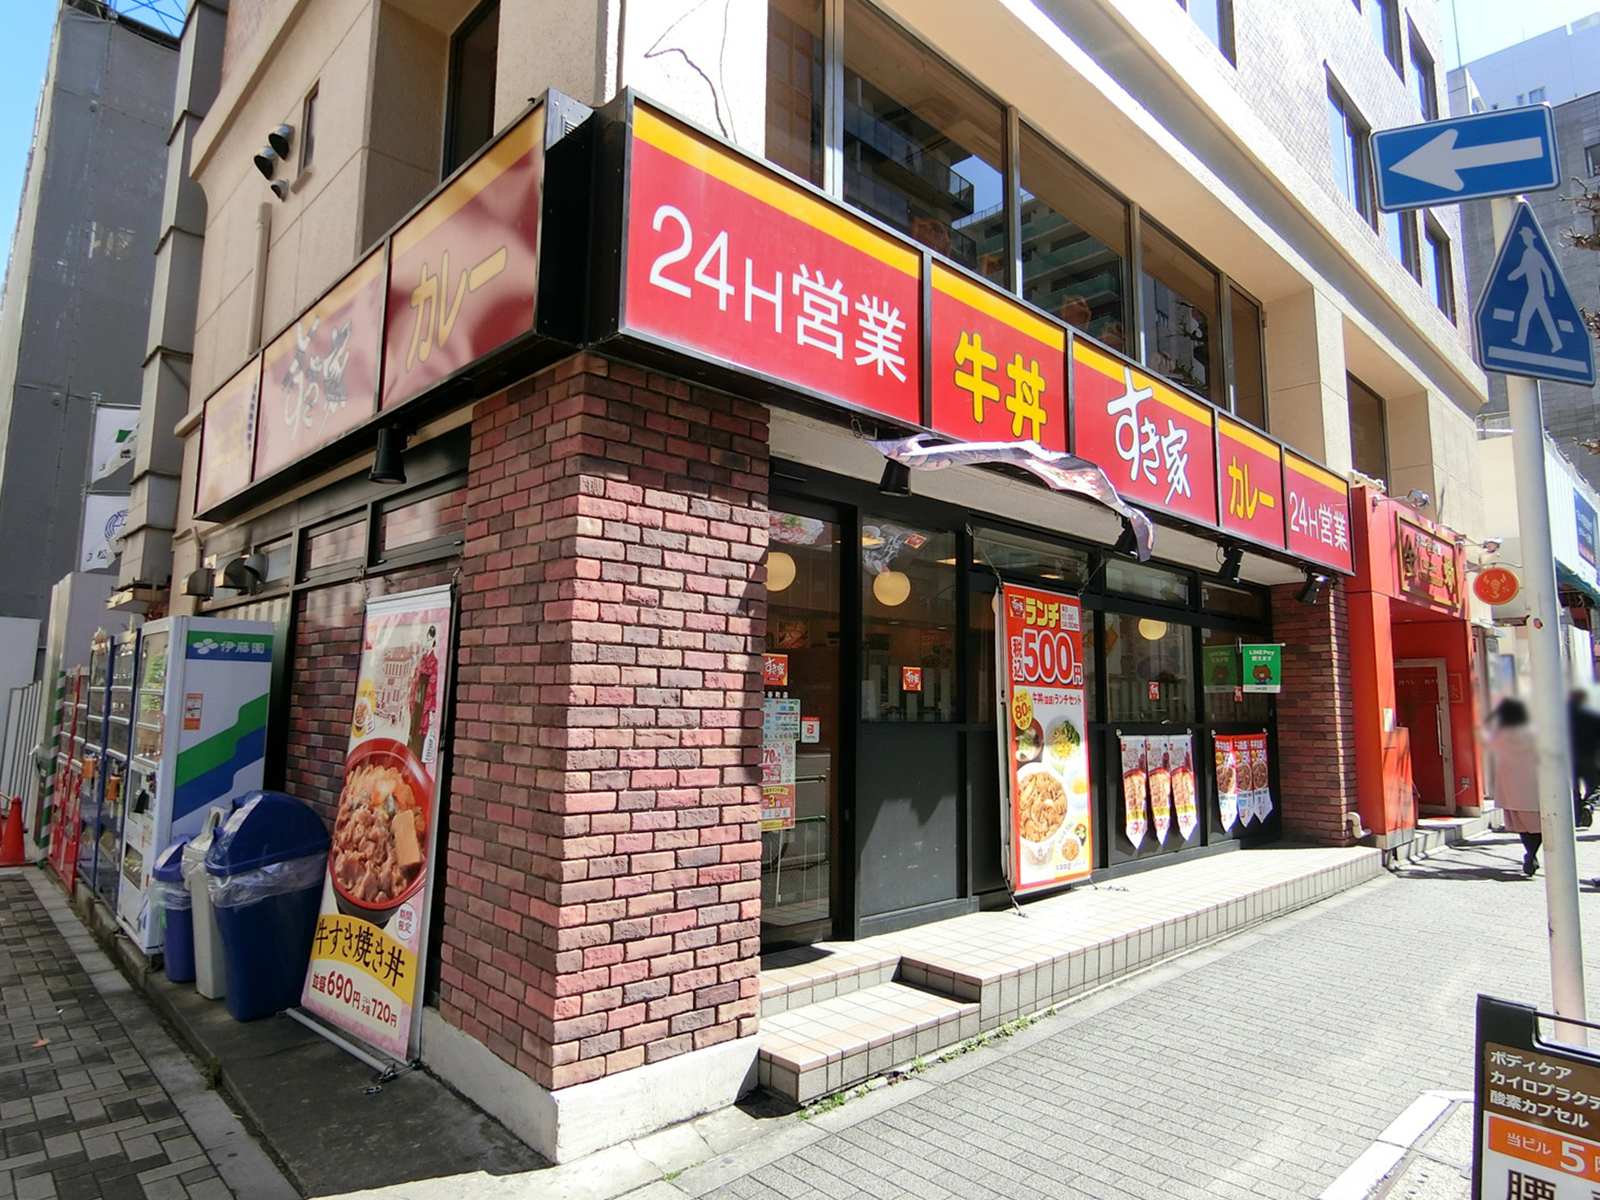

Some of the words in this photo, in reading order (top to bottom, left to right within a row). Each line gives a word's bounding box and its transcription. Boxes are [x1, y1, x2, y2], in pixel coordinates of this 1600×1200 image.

[405, 245, 508, 373] カレー
[649, 204, 907, 384] 24H営業
[953, 329, 1047, 443] 牛丼
[1106, 365, 1192, 505] すき家
[1227, 455, 1277, 521] カレー
[1289, 490, 1349, 552] 24H営業
[1025, 597, 1060, 629] ランチ
[220, 640, 265, 655] 伊藤園
[1012, 636, 1024, 681] 税込
[1023, 628, 1083, 685] 500円
[398, 921, 412, 934] 限定
[400, 909, 413, 923] 期間
[315, 918, 405, 987] 牛すき焼き丼
[327, 970, 361, 1011] 690円
[371, 997, 397, 1028] 720円
[1489, 1050, 1573, 1080] ボディケア
[1489, 1089, 1590, 1129] 酸素カプセル
[1506, 1131, 1552, 1156] 当ビル
